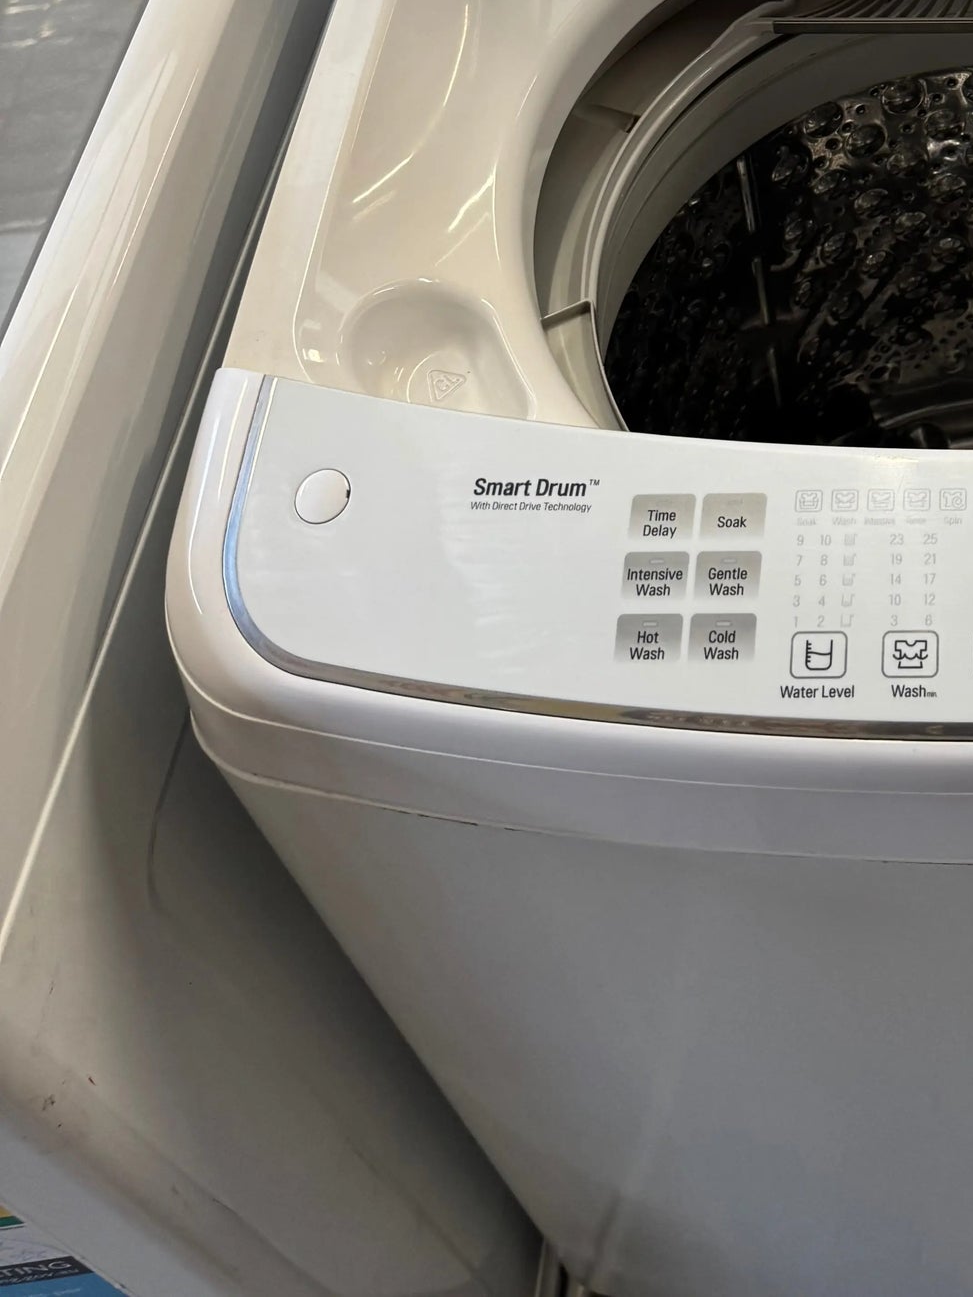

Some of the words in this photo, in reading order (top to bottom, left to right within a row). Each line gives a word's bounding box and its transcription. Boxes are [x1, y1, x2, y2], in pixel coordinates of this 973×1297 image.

[473, 477, 531, 497] Smart
[470, 501, 491, 511] With
[492, 501, 517, 511] Direct
[519, 502, 541, 511] Drive
[543, 502, 592, 513] Technology
[648, 509, 676, 522] Time
[717, 516, 747, 528] Soak
[642, 524, 677, 539] Delay
[820, 534, 831, 546] 10
[890, 534, 904, 545] 23
[923, 534, 938, 545] 25
[891, 554, 902, 565] 19
[924, 553, 937, 565] 21
[627, 568, 683, 581] Intensive
[708, 567, 748, 580] Gentle
[890, 574, 901, 585] 14
[924, 574, 936, 584] 17
[636, 584, 671, 596] Wash
[709, 583, 745, 596] Wash
[890, 594, 901, 605] 10
[924, 594, 935, 605] 12
[637, 631, 659, 644] Hot
[708, 630, 736, 644] Cold
[629, 648, 665, 661] Wash
[703, 647, 739, 661] Wash
[780, 686, 818, 698] Water
[822, 685, 855, 698] Level
[891, 684, 926, 697] Wash
